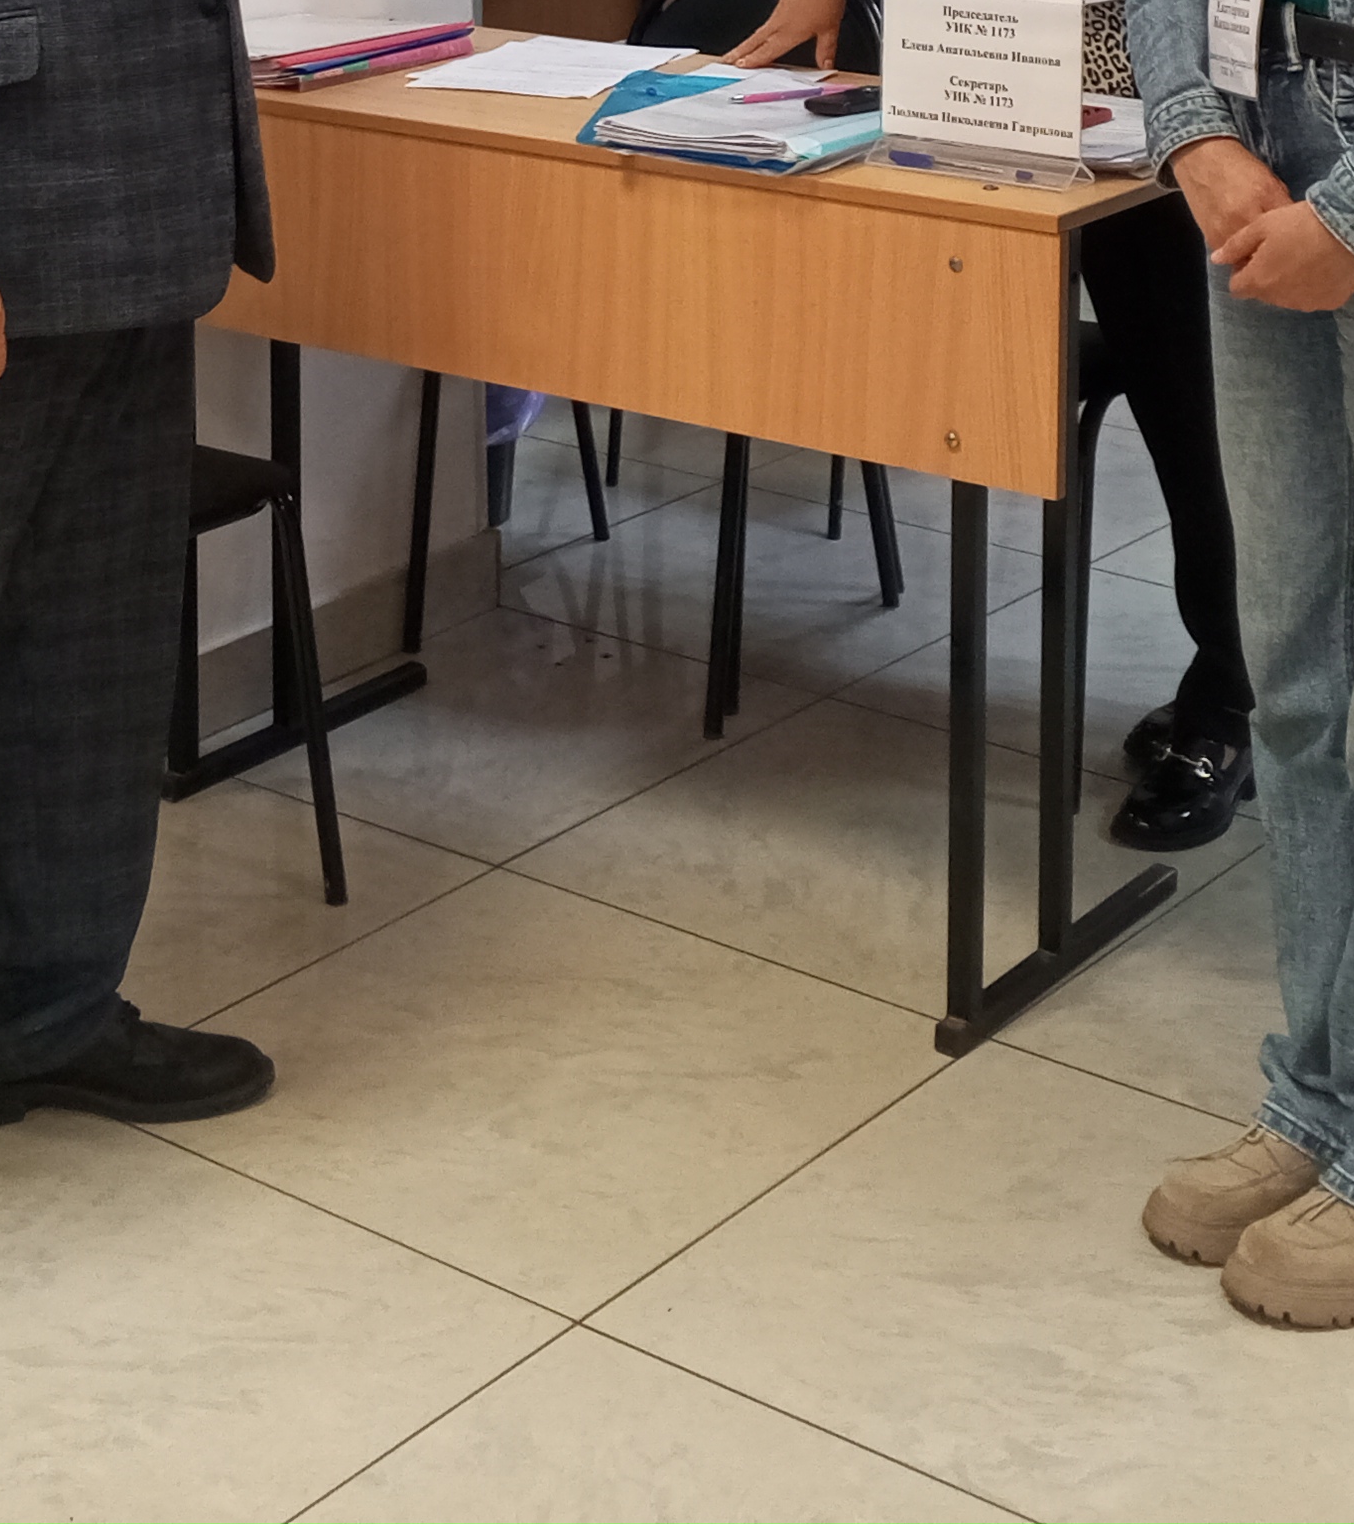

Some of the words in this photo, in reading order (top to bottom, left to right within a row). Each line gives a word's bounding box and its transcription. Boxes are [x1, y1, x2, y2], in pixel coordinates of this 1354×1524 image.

[943, 6, 1019, 24] Председатель
[945, 21, 973, 36] УИК
[974, 24, 988, 36] №
[991, 26, 1016, 39] 1173
[901, 38, 934, 53] Елена
[936, 43, 1009, 61] Анатольевна
[1011, 51, 1061, 67] Иванова
[949, 75, 1009, 93] Секретарь
[944, 89, 971, 103] УИК
[973, 93, 987, 105] №
[990, 95, 1014, 109] 1173
[887, 105, 939, 122] Людмила
[1011, 121, 1074, 139] Гаврилова
